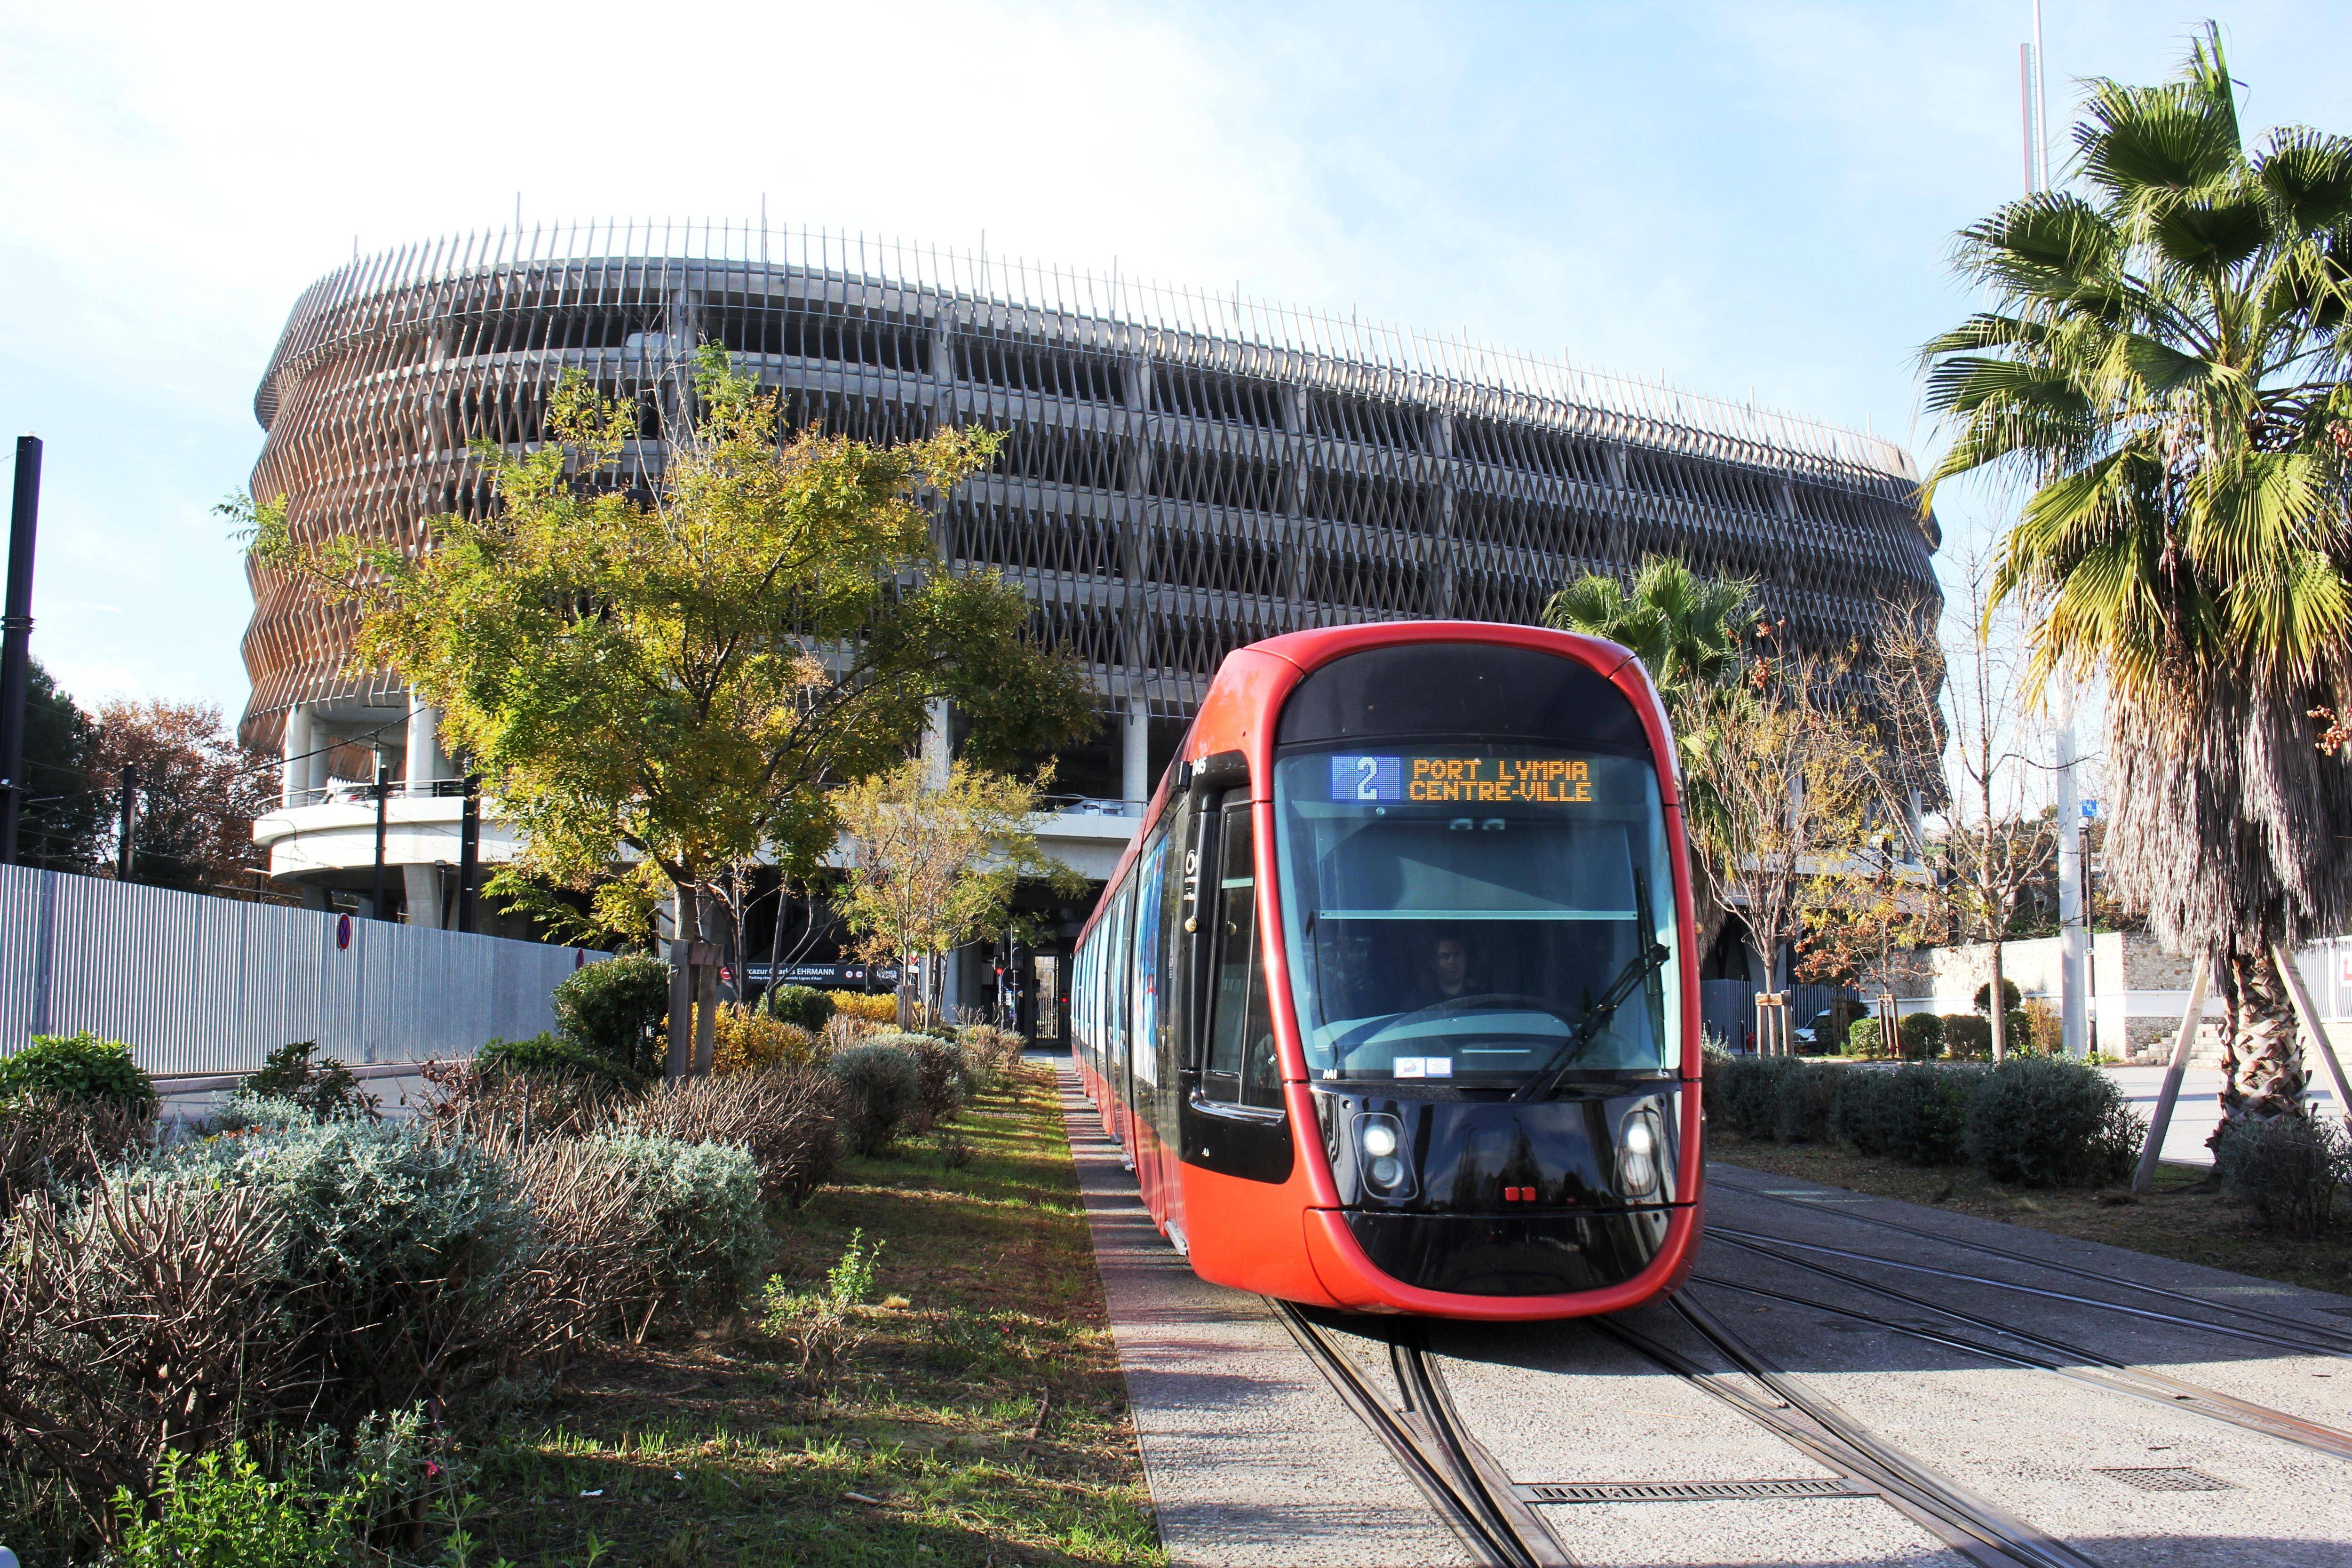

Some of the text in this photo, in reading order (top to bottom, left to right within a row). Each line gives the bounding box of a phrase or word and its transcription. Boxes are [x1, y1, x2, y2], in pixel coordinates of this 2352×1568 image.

[1192, 756, 1207, 776] 045
[1414, 760, 1588, 780] PORT LYMPIA
[1357, 757, 1377, 800] 2
[1410, 781, 1592, 802] CENTRE-VILLE
[2082, 800, 2096, 816] SOS
